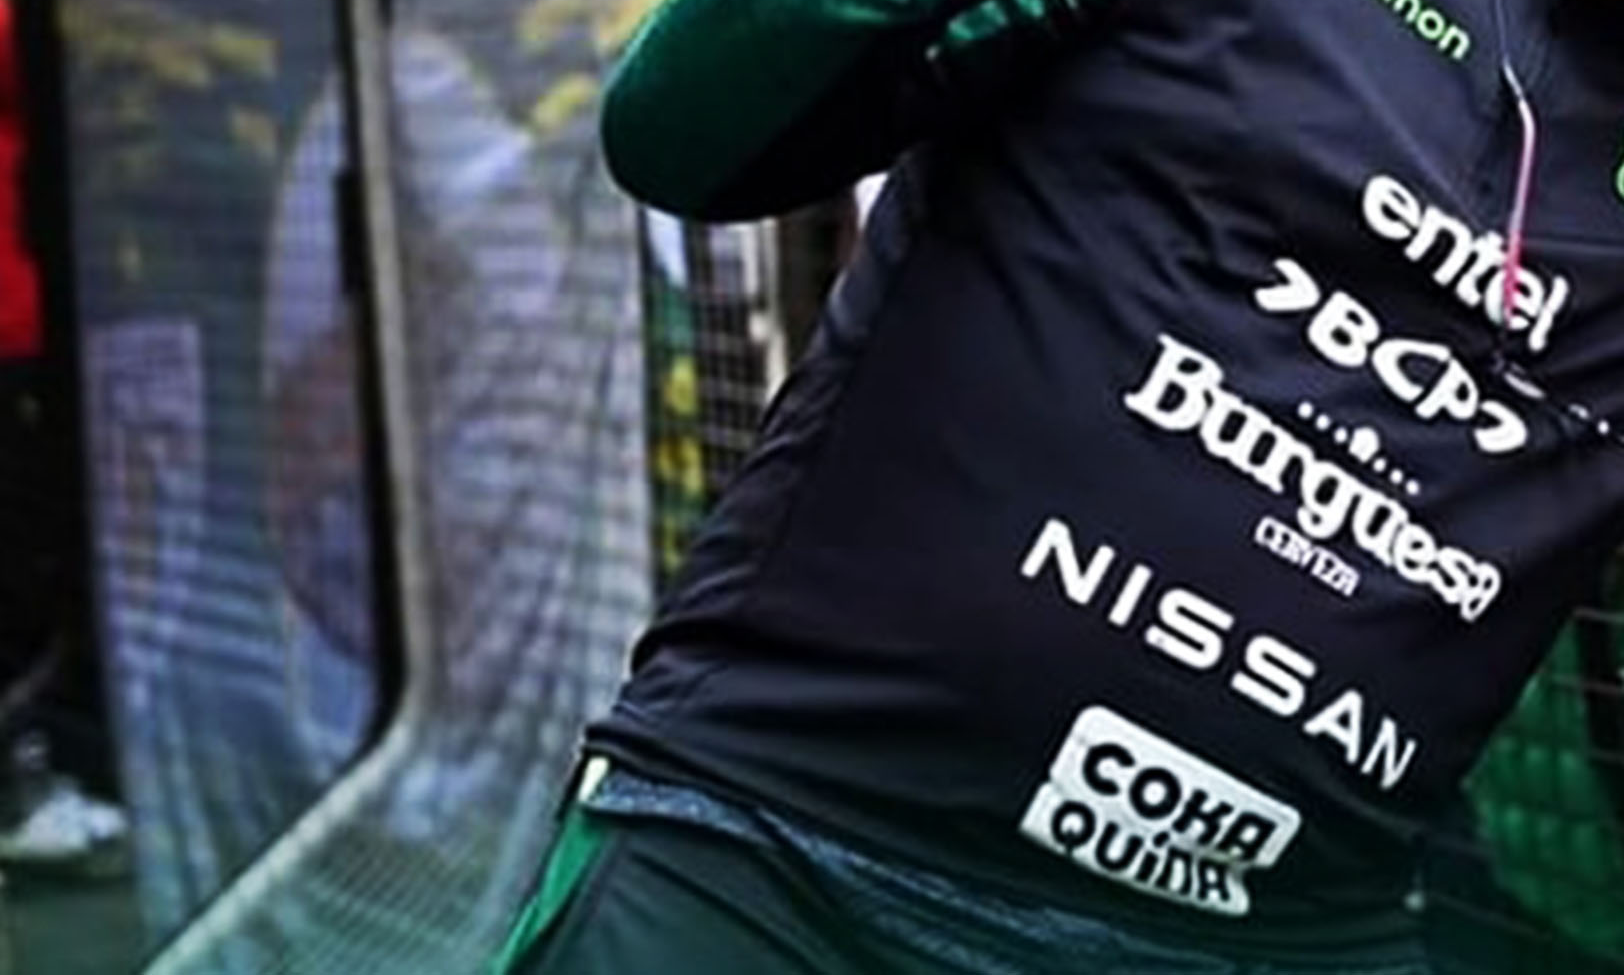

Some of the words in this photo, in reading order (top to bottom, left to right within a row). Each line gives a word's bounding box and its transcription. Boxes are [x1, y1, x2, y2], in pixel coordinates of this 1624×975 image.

[1362, 175, 1568, 351] entel
[1020, 518, 1416, 790] NISSAN
[1082, 743, 1278, 861] COKA
